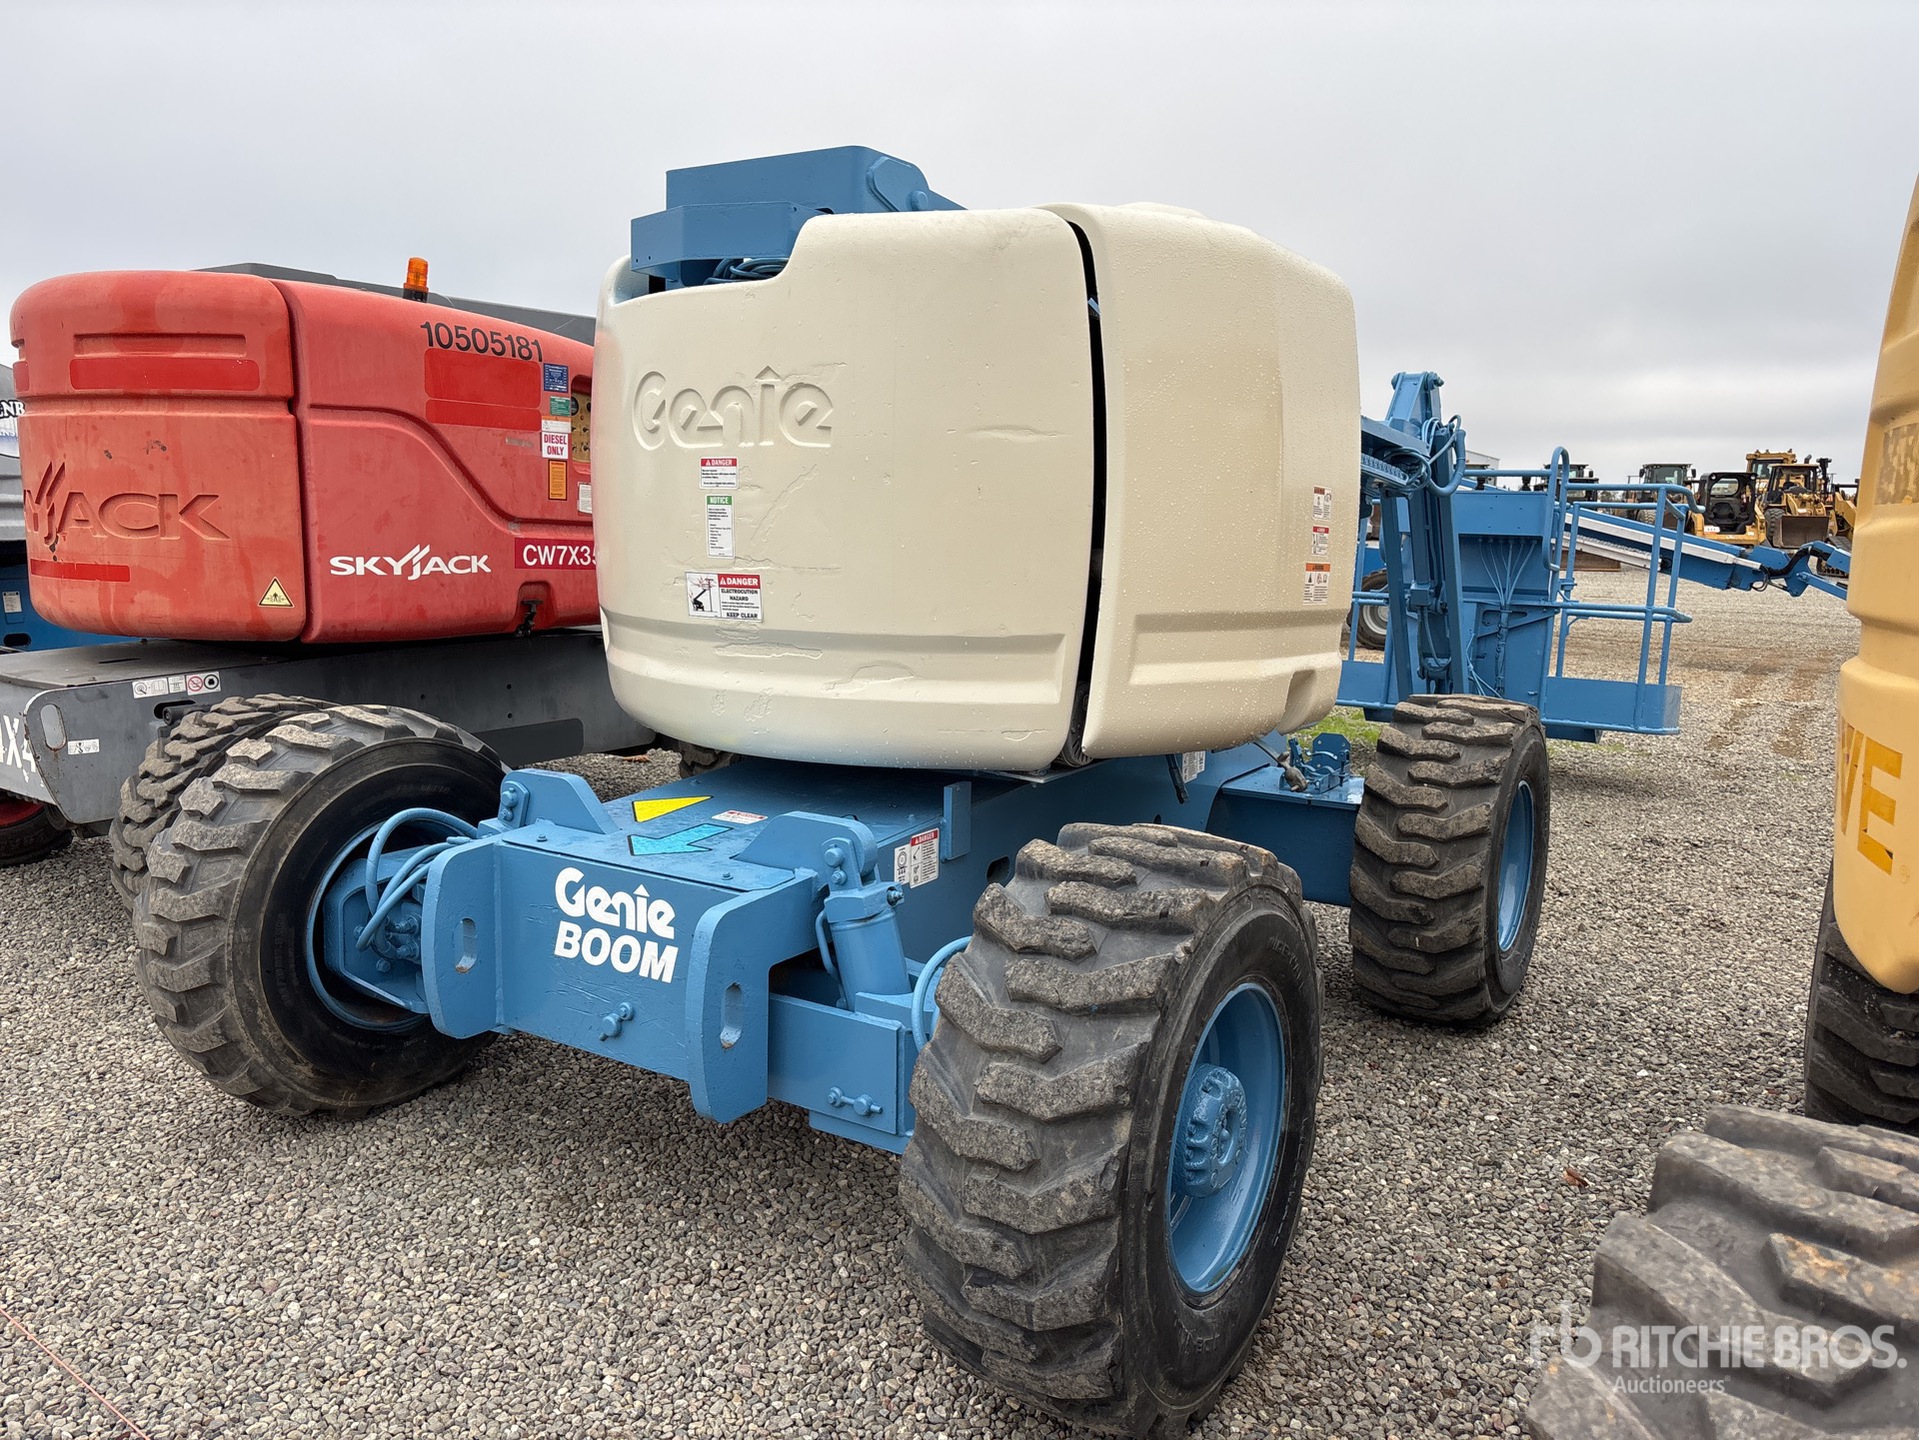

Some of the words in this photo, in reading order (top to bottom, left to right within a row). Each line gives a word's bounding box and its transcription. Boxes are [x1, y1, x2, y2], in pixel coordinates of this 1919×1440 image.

[420, 321, 543, 362] 10505181
[633, 366, 833, 450] Genie
[543, 434, 567, 444] DIESEL
[546, 446, 565, 456] ONLY
[24, 461, 231, 547] YJACK
[709, 496, 729, 504] NOTICE
[329, 544, 492, 580] SKYJACK
[727, 578, 758, 586] DANGER
[554, 866, 676, 940] Genie
[554, 920, 679, 983] BOOM
